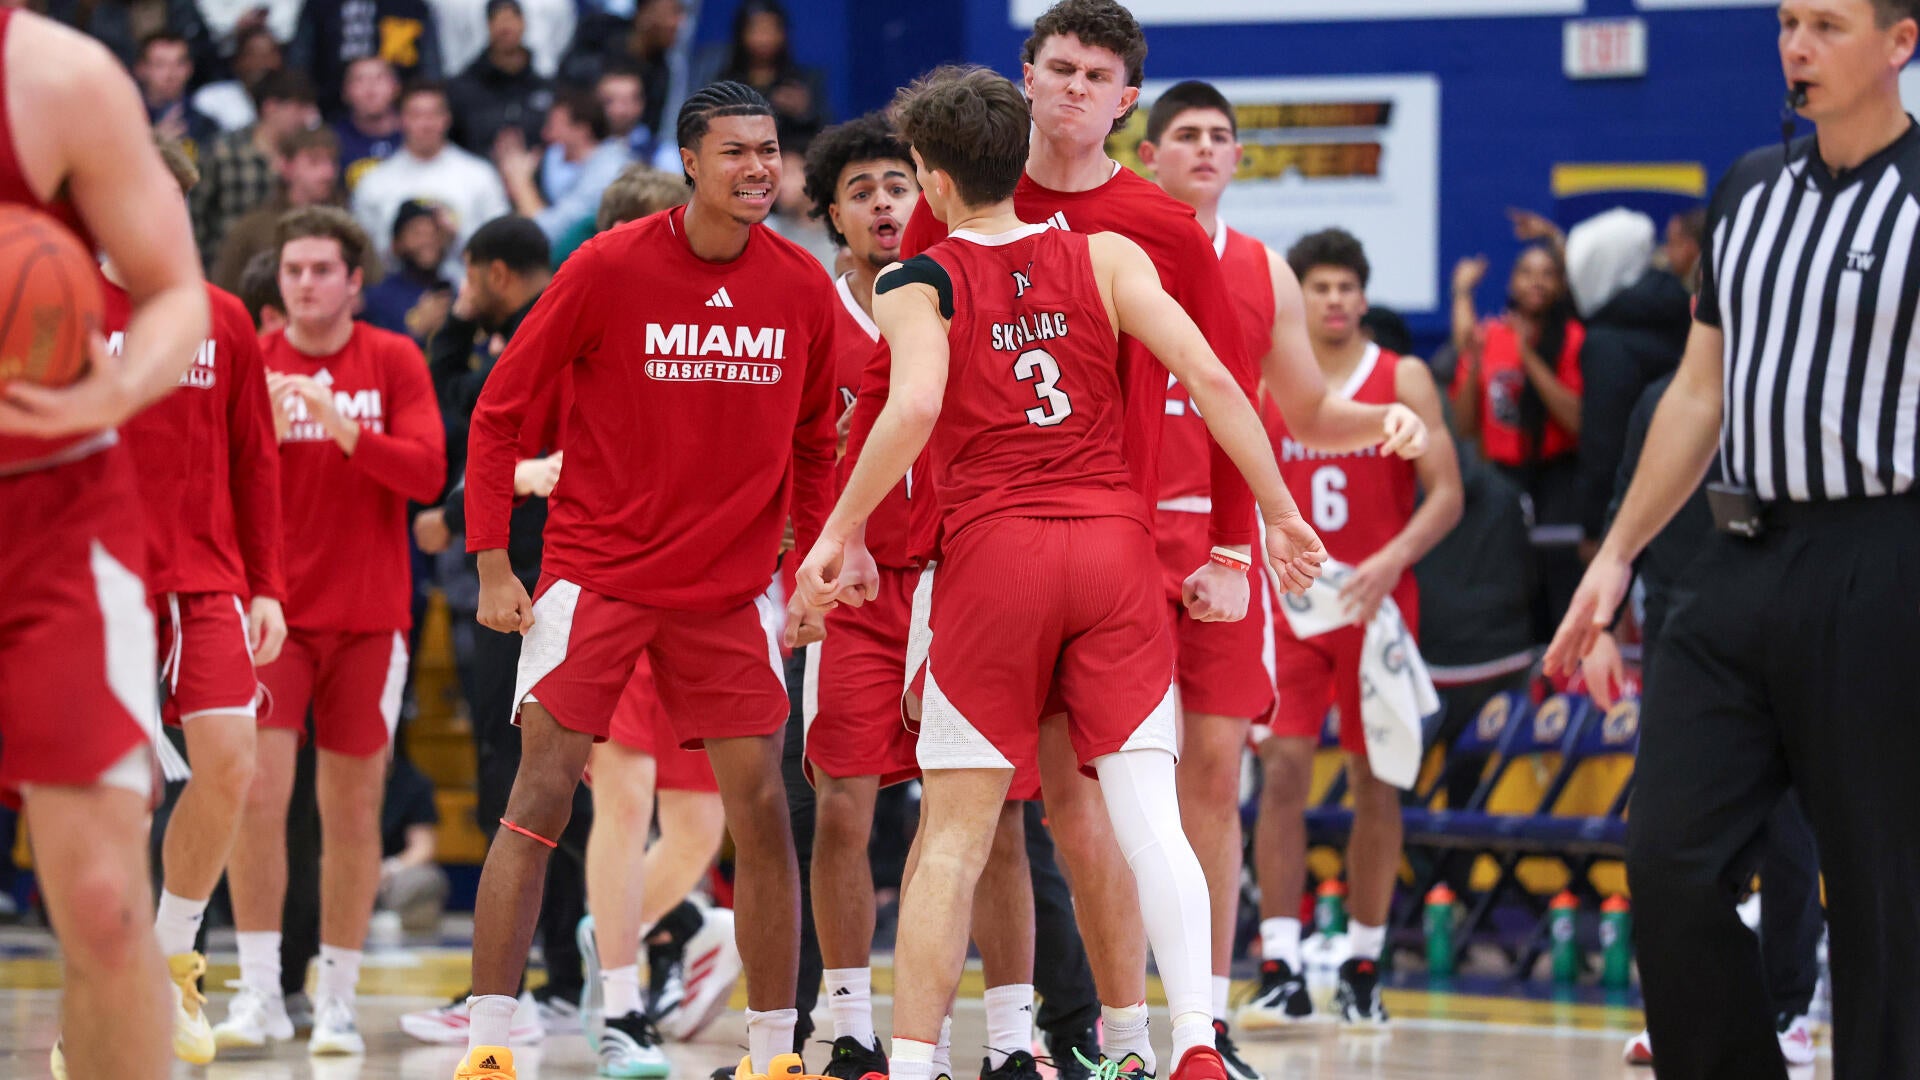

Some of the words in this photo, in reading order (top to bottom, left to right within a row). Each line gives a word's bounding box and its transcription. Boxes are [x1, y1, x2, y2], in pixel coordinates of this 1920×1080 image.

[1846, 252, 1875, 271] TW
[645, 323, 786, 360] MIAMI
[655, 362, 771, 381] BASKETBALL
[1013, 348, 1073, 427] 3
[1310, 465, 1349, 532] 6
